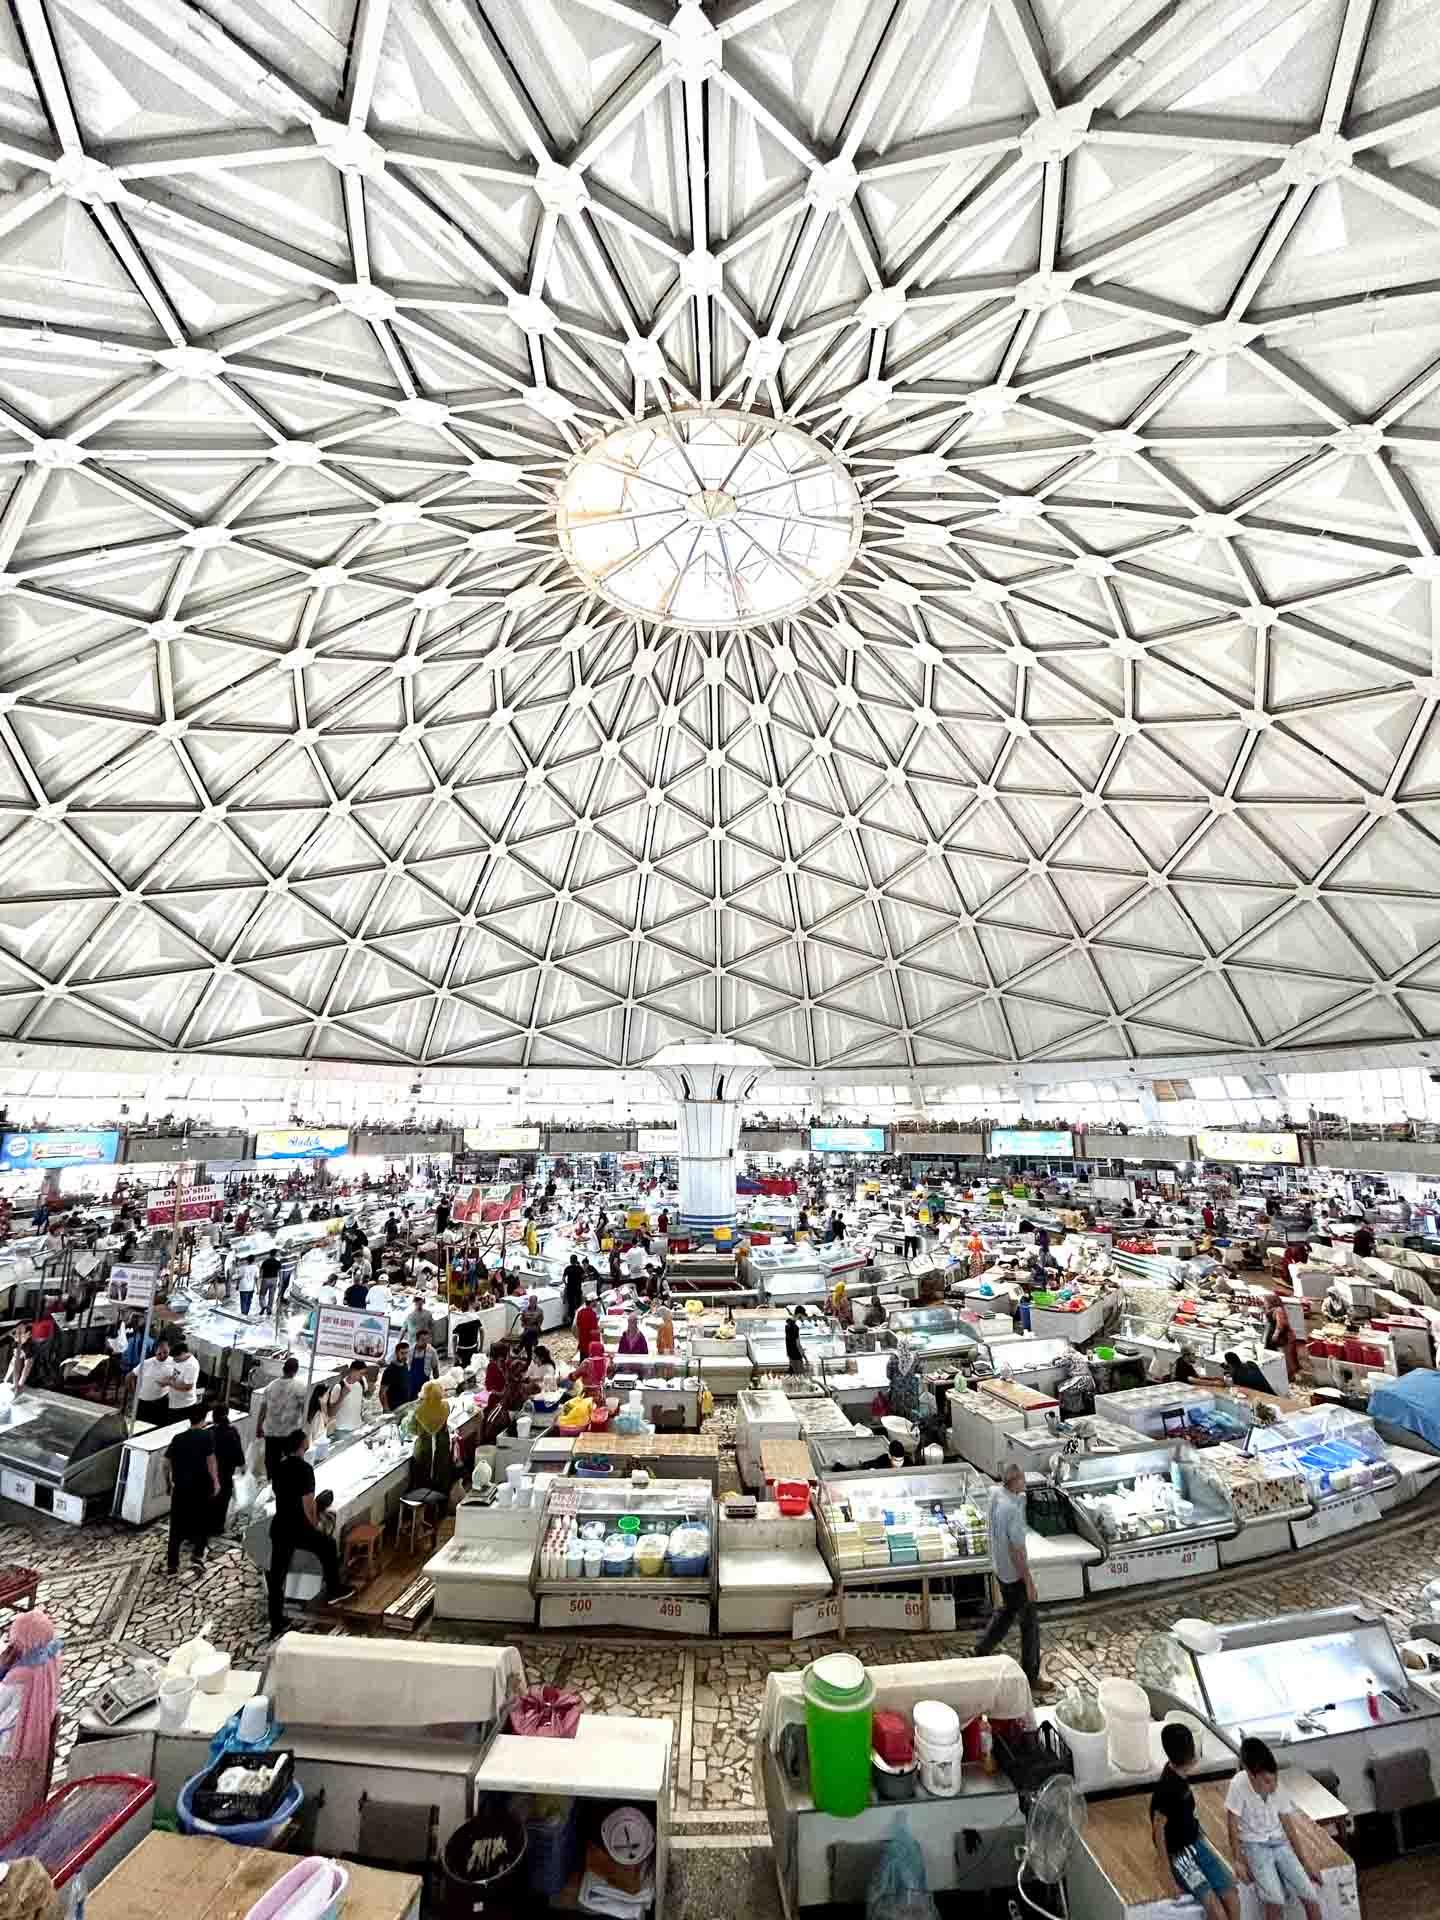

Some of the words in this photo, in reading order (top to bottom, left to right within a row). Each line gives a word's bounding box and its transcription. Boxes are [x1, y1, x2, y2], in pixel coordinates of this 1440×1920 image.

[569, 1599, 592, 1612] 500
[659, 1603, 681, 1616] 499
[905, 1600, 922, 1616] 60
